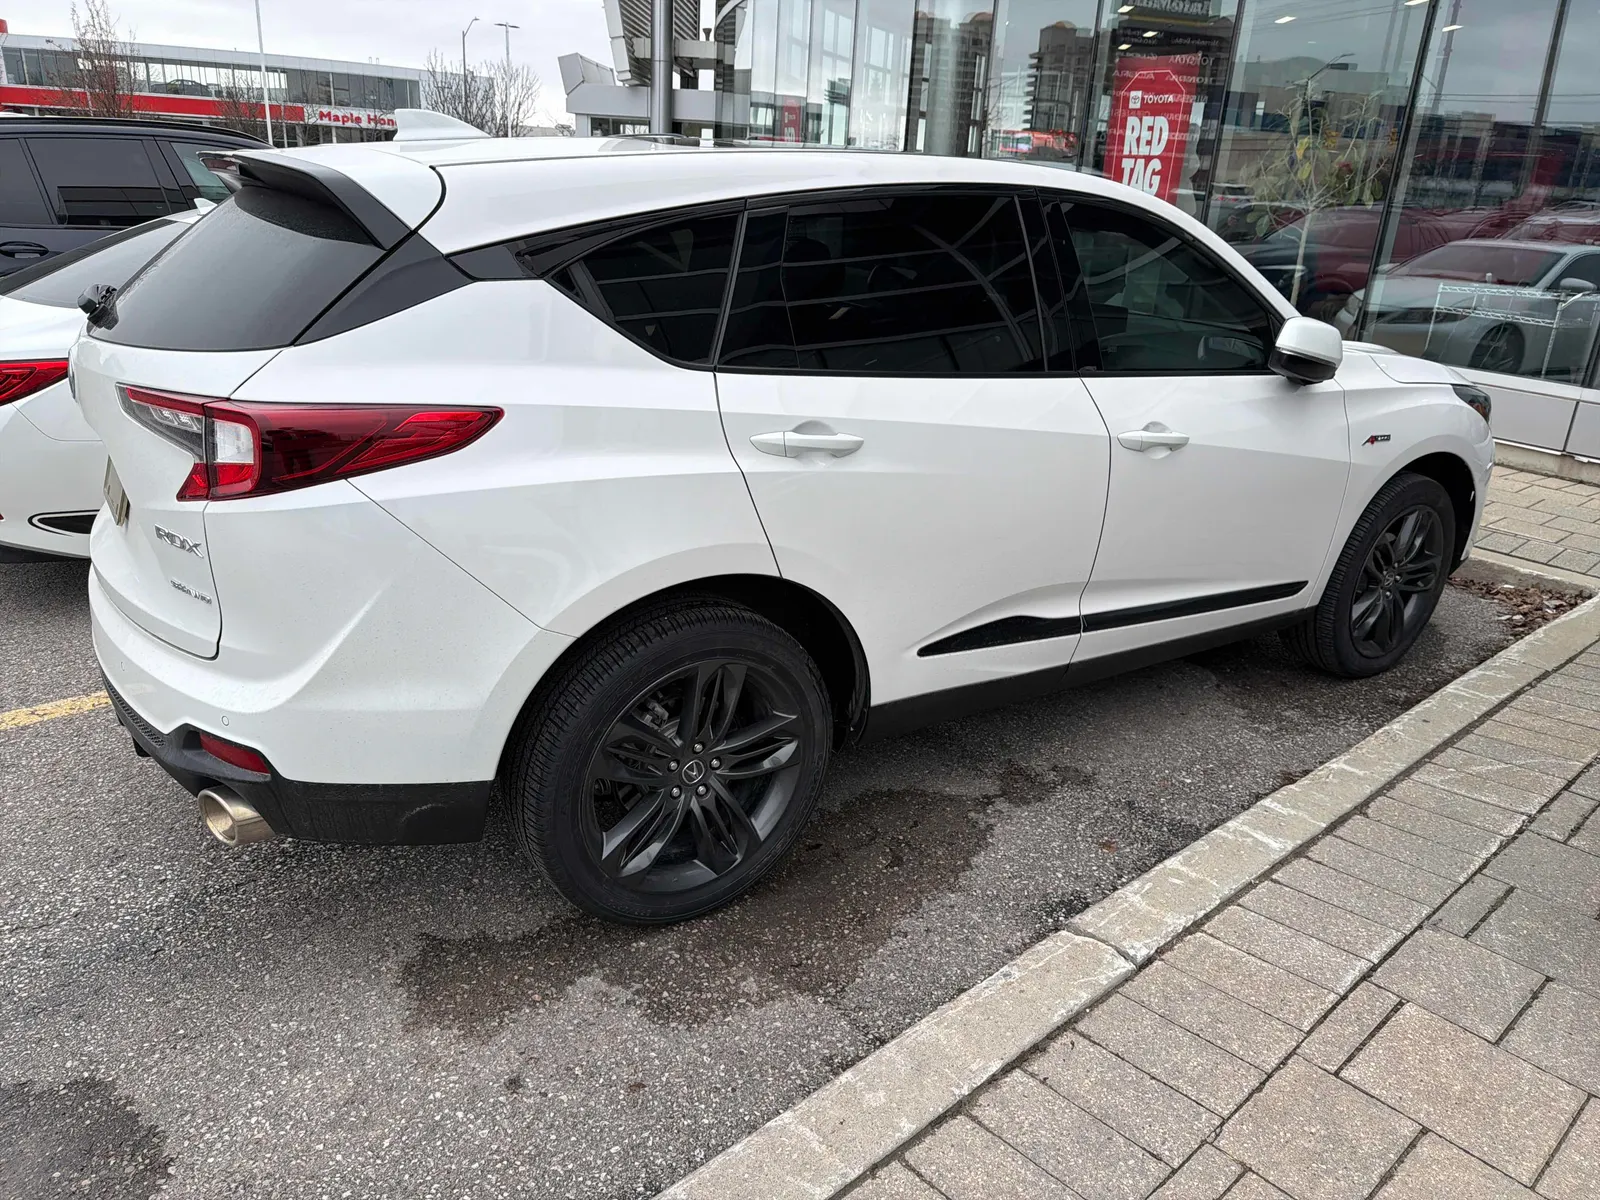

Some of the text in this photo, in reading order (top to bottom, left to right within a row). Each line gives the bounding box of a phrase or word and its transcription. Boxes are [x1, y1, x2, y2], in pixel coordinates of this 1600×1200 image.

[1143, 94, 1174, 104] TOYOTA
[319, 110, 398, 126] Maple Hon
[1123, 115, 1169, 156] RED
[1121, 158, 1162, 197] TAG
[154, 523, 205, 559] RDX
